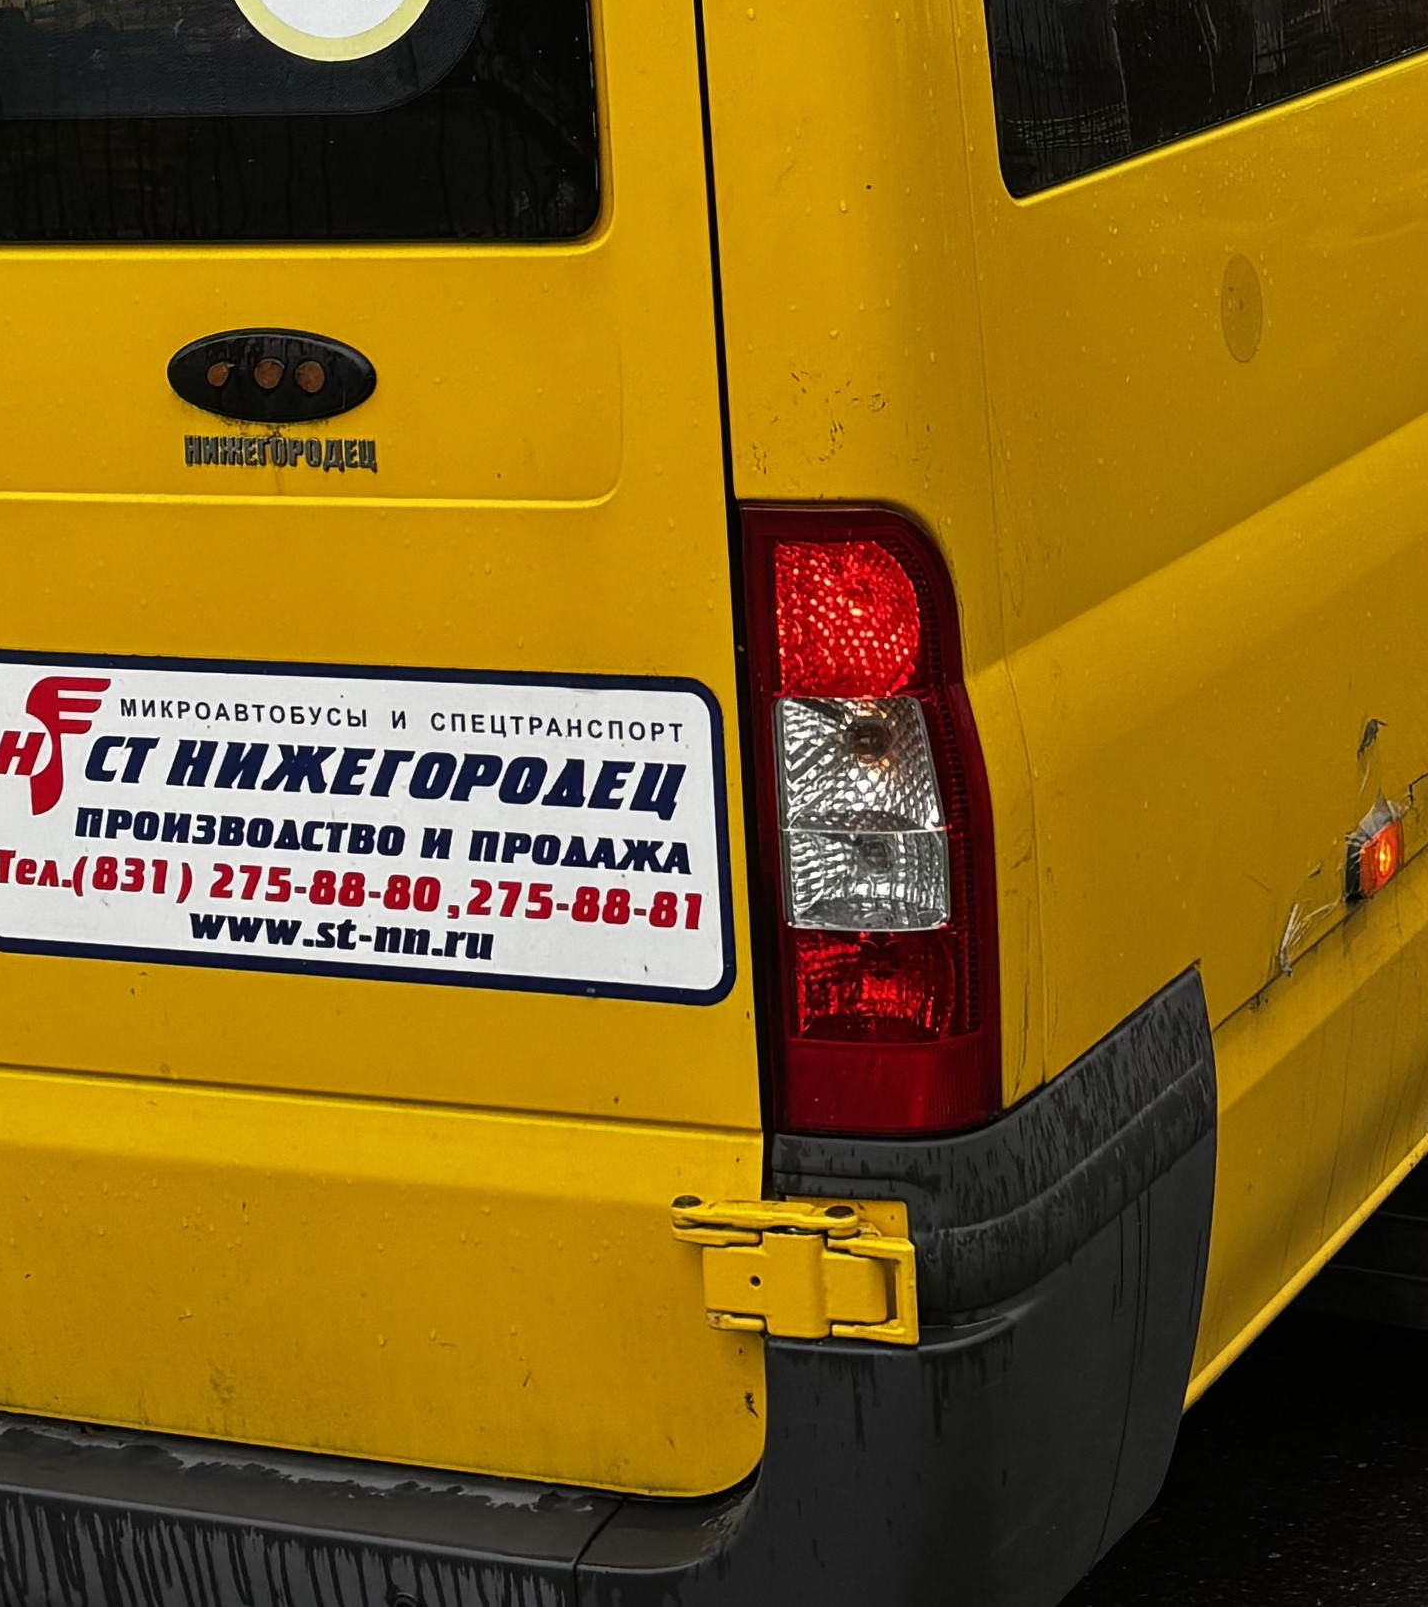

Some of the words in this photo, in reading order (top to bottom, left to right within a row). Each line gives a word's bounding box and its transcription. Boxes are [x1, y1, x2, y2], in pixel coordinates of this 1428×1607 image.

[184, 434, 378, 474] НИЖЕГОРОДЕЦ
[120, 697, 367, 728] МИКРОАВТОБУСЫ
[391, 710, 407, 730] И
[430, 711, 684, 743] СПЕЦТРАНСПОРТ
[84, 735, 160, 784] СТ
[165, 739, 687, 821] НИЖЕГОРОДЕЦ
[75, 807, 406, 857] ПРОИЗВОДСТВО
[420, 827, 453, 860] И
[468, 829, 692, 875] ПРОДАЖА
[189, 912, 494, 960] www.st-nn.ru
